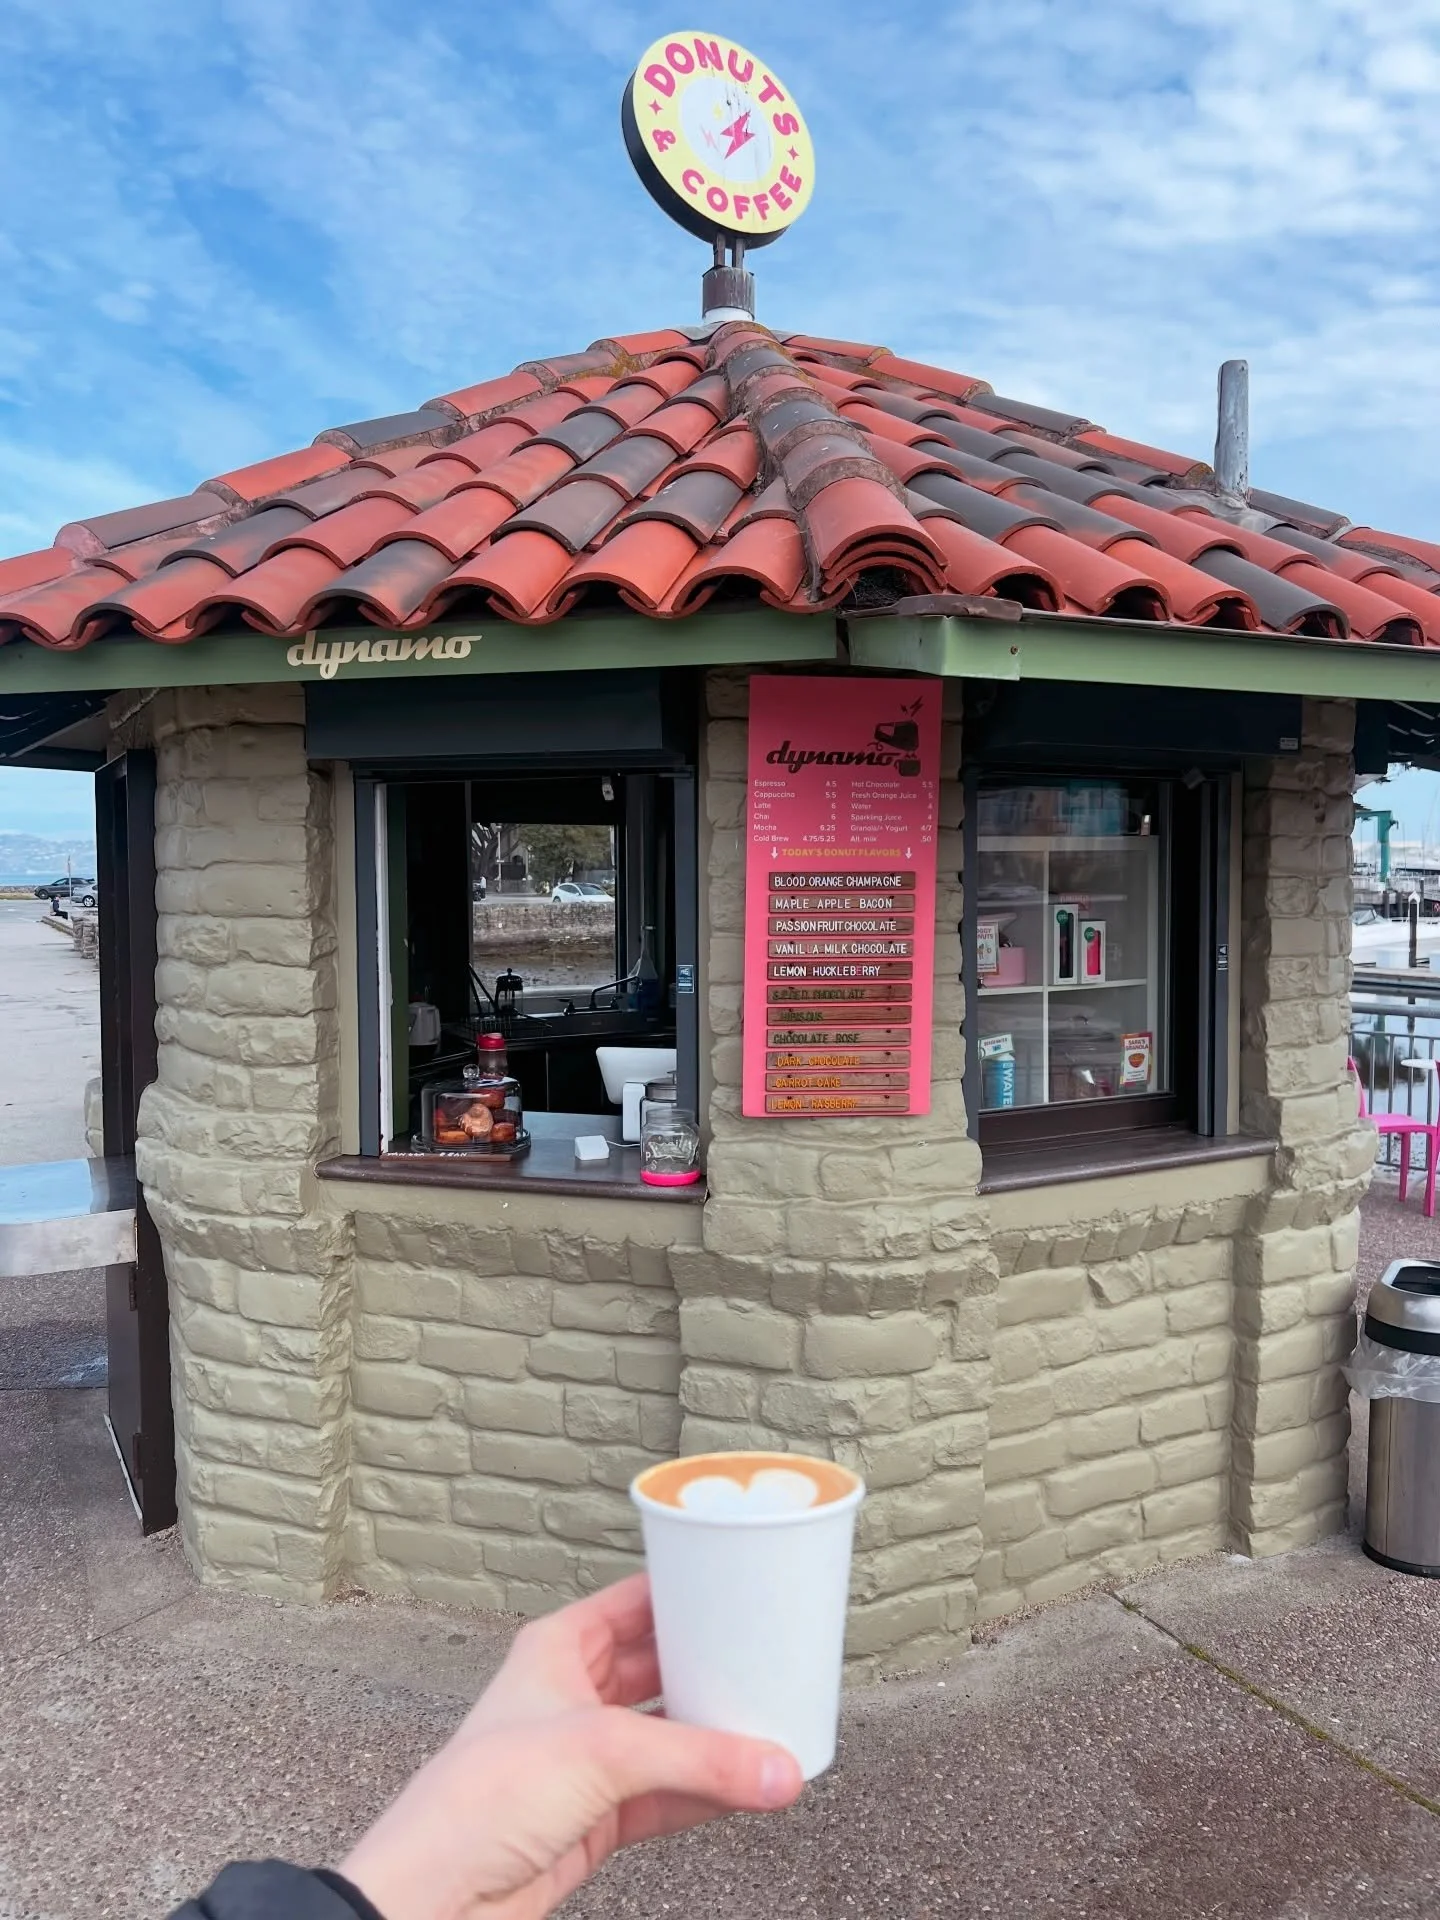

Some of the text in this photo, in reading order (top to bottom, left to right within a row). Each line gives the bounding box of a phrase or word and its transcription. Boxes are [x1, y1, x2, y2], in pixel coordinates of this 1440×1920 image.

[644, 38, 800, 136] DONUTS
[682, 165, 802, 221] COFFEE
[287, 630, 483, 679] dynamo
[766, 741, 901, 774] dynamo
[754, 779, 786, 787] Espresso
[871, 792, 897, 800] Orange
[885, 825, 908, 833] Yogurt
[782, 848, 901, 857] TODAY'S DONUT FLAVORS
[774, 876, 902, 887] BLOOD ORANGE CHAMPAGNE
[775, 898, 893, 909] MAPLE APPLE BACON
[844, 921, 897, 931] CHOCOLATE
[775, 943, 907, 954] VANILLA MILK CHOCOLATE
[773, 965, 881, 977] LEMON HUCKLEBERRY
[773, 1033, 860, 1044] CHOCOLATE ROSE
[777, 1055, 860, 1067] DARK CHOCOLATE
[775, 1077, 841, 1089] CARROT CAKE
[770, 1099, 801, 1110] LEMON
